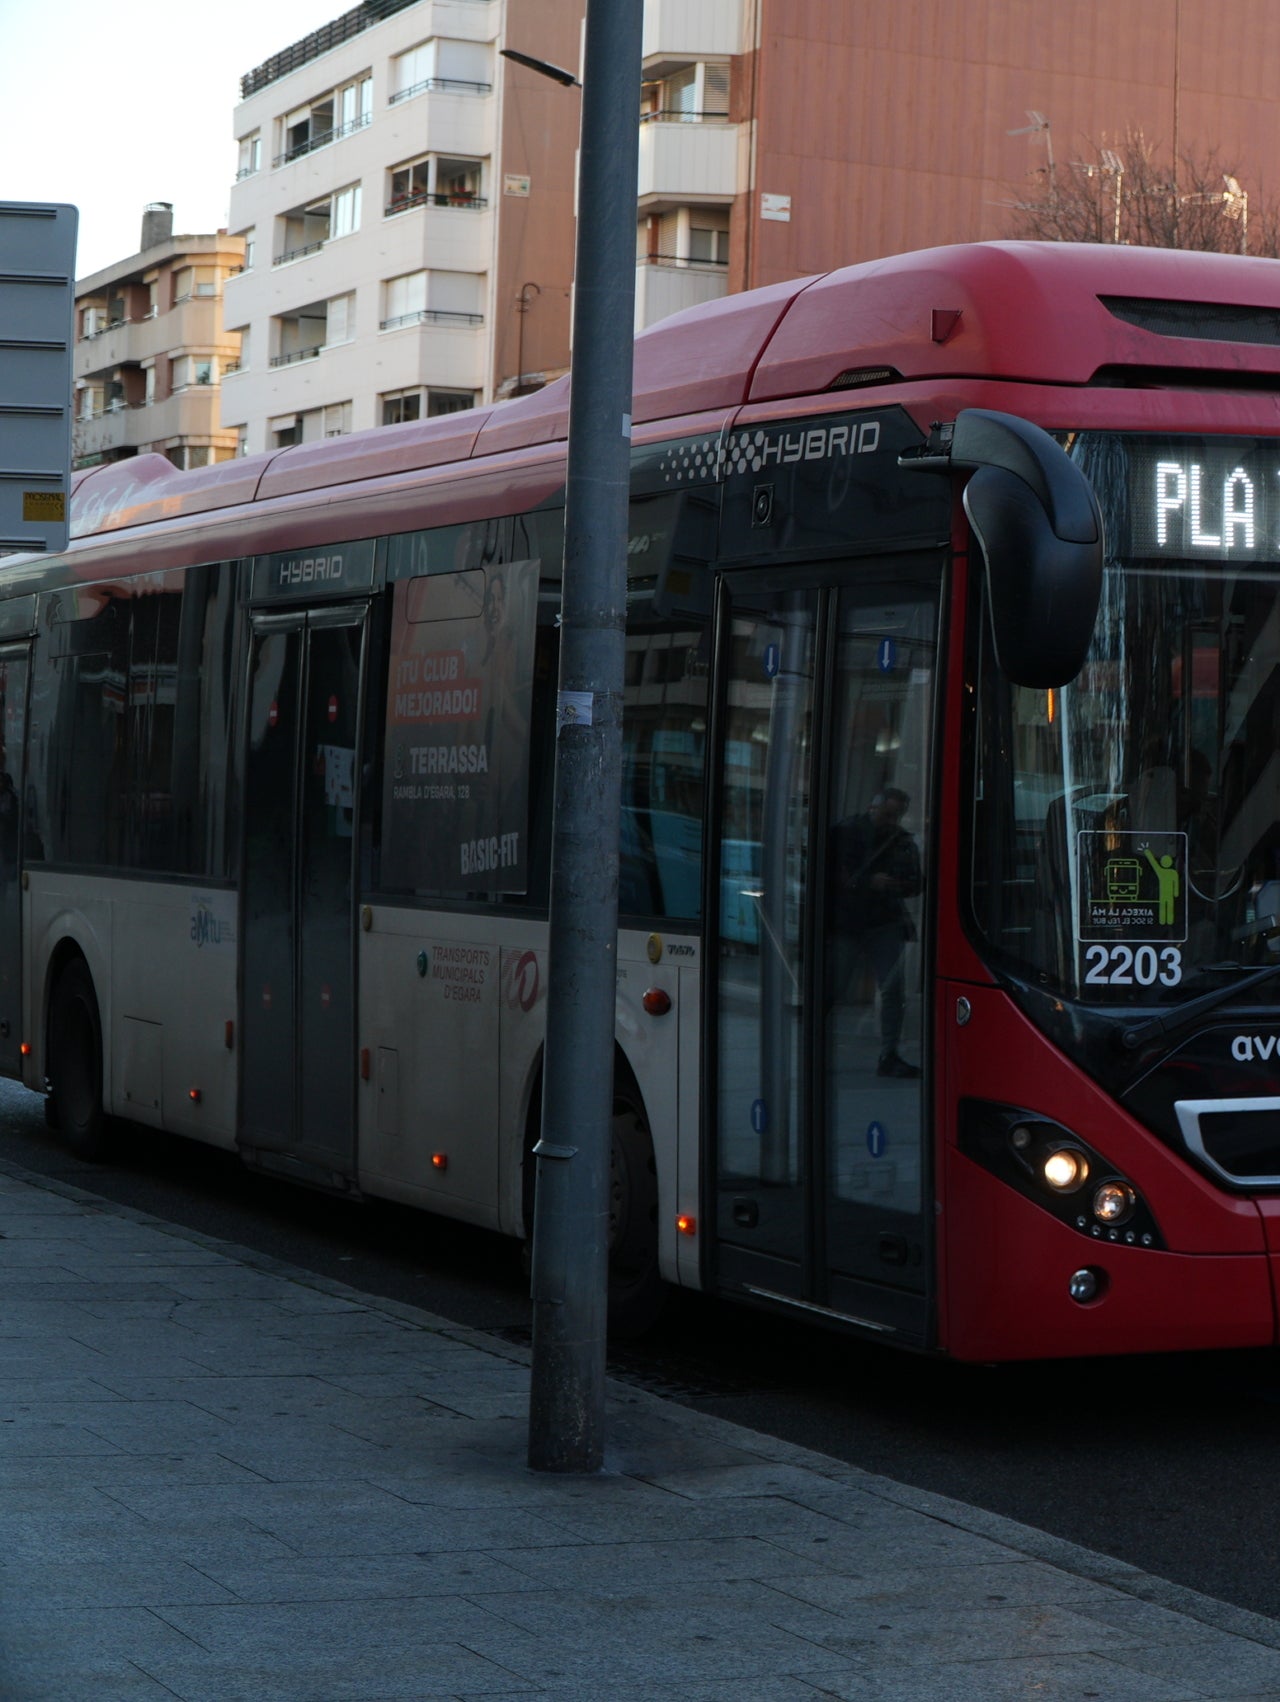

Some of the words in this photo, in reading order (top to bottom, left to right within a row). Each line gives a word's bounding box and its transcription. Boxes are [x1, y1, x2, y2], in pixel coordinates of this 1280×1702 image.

[762, 421, 880, 466] HYBRID
[1157, 462, 1254, 548] PLA
[279, 555, 343, 585] HYBRID
[424, 656, 458, 682] CLUB
[394, 688, 479, 718] MEJORADO!
[410, 744, 488, 775] TERRASSA
[460, 831, 519, 876] BASIC-FIT
[432, 946, 490, 966] TRANSPORTS
[1084, 944, 1183, 987] 2203
[431, 965, 485, 985] MUNICIPALS
[444, 984, 481, 1002] D'EGARA
